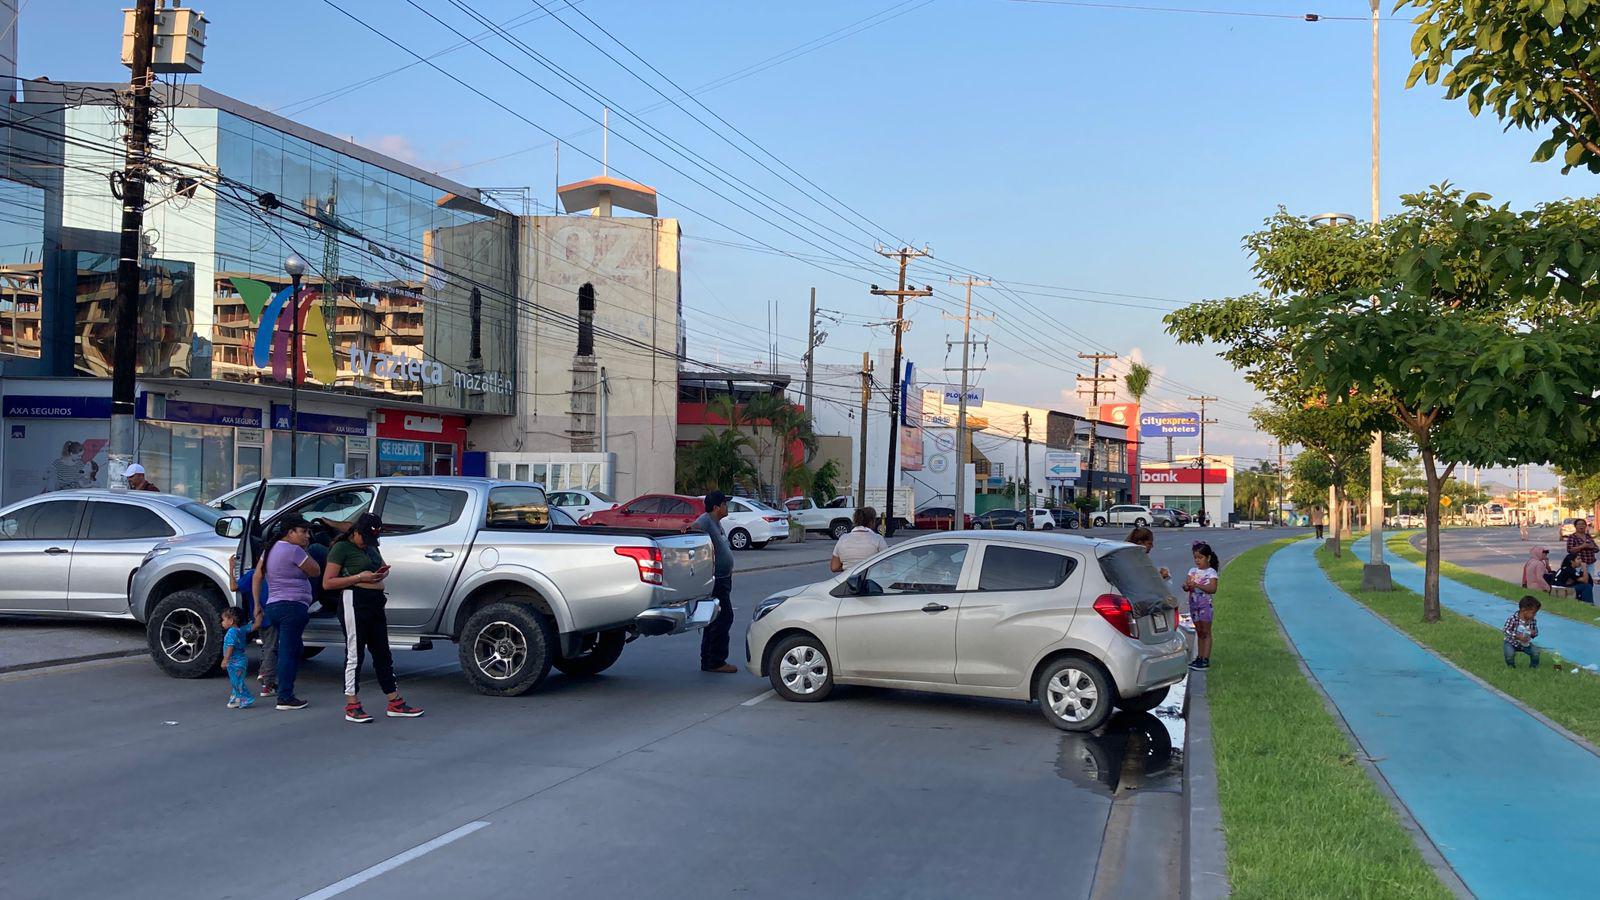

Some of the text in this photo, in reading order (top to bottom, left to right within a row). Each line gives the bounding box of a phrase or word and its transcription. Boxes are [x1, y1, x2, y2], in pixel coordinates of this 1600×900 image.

[350, 342, 372, 375] tv
[375, 351, 443, 385] azteca
[946, 392, 978, 400] PLORÍA
[9, 407, 72, 416] AXA SEGUROS
[221, 416, 259, 426] AXA SEGUROS
[1162, 425, 1196, 433] hoteles
[381, 442, 390, 455] SE
[391, 443, 421, 456] RENTA
[1140, 469, 1178, 482] bank
